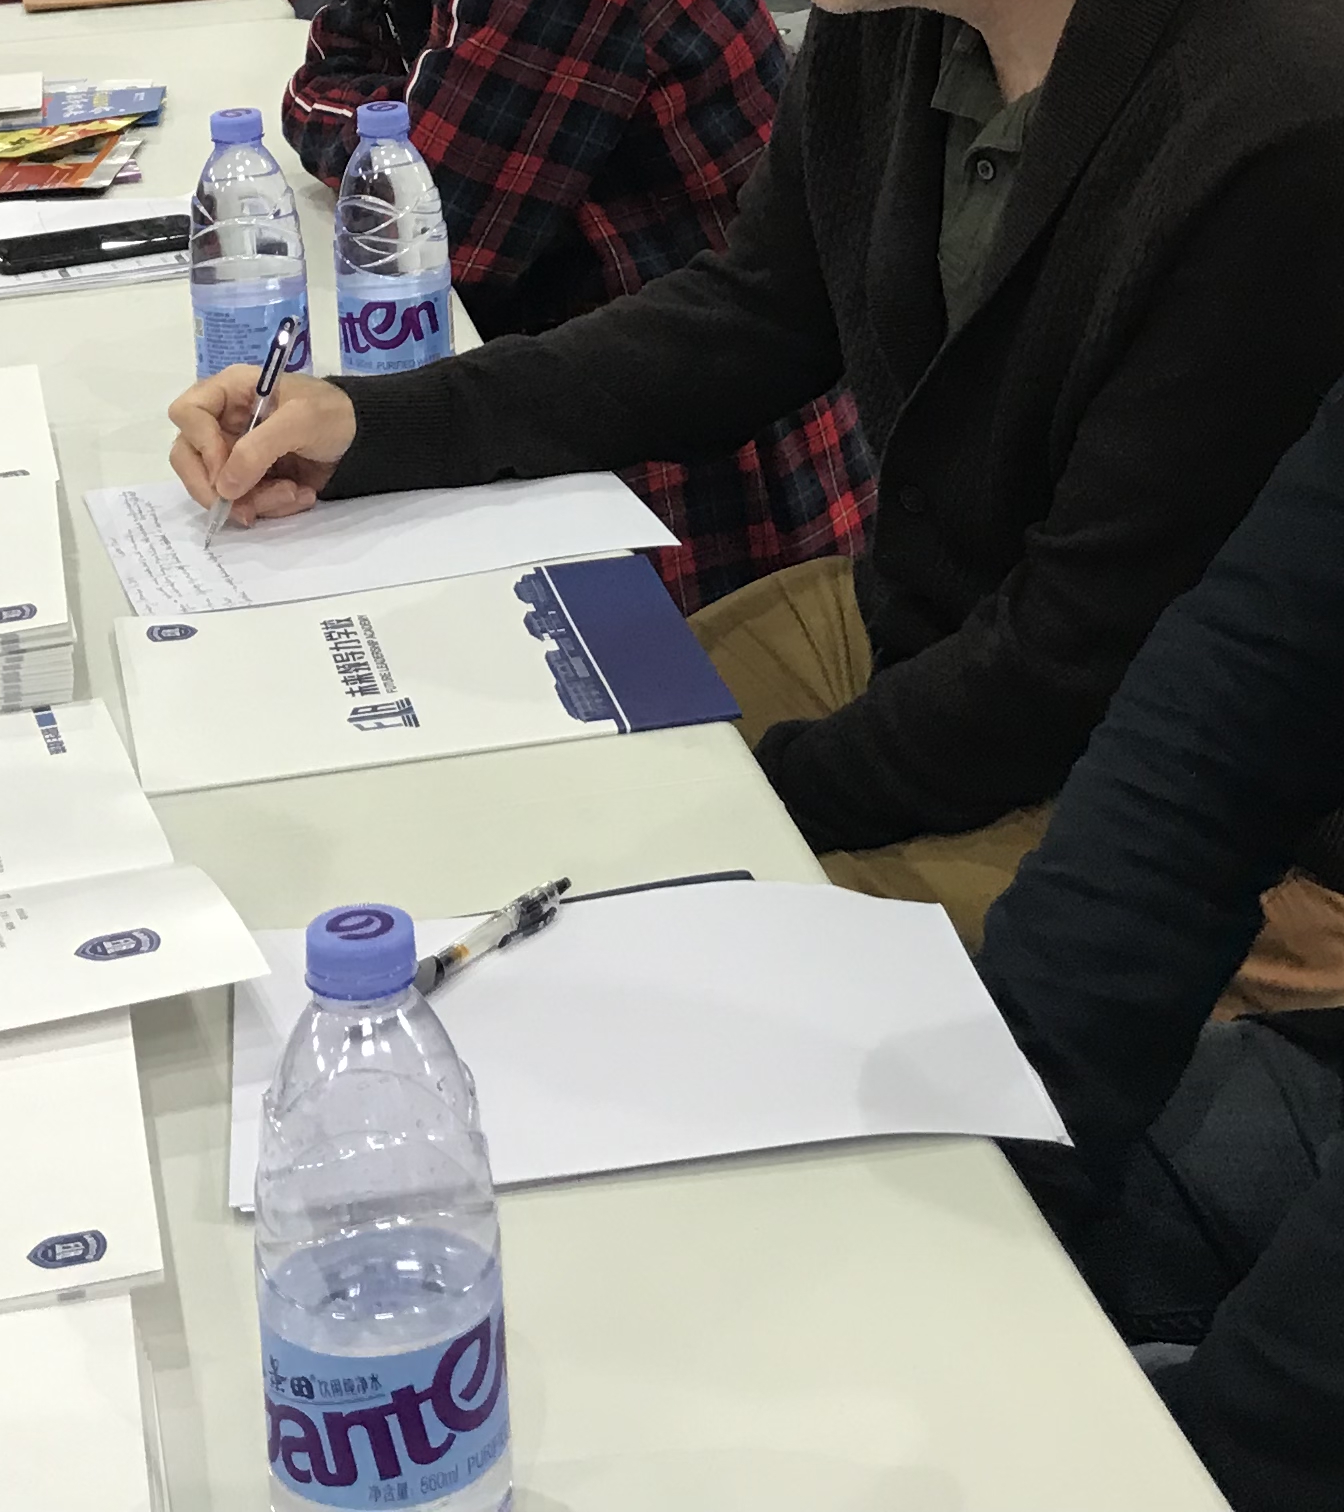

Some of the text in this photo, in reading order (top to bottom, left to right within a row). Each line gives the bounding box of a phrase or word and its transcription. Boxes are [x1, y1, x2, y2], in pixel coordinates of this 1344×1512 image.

[320, 616, 381, 698] 未来领导力学校
